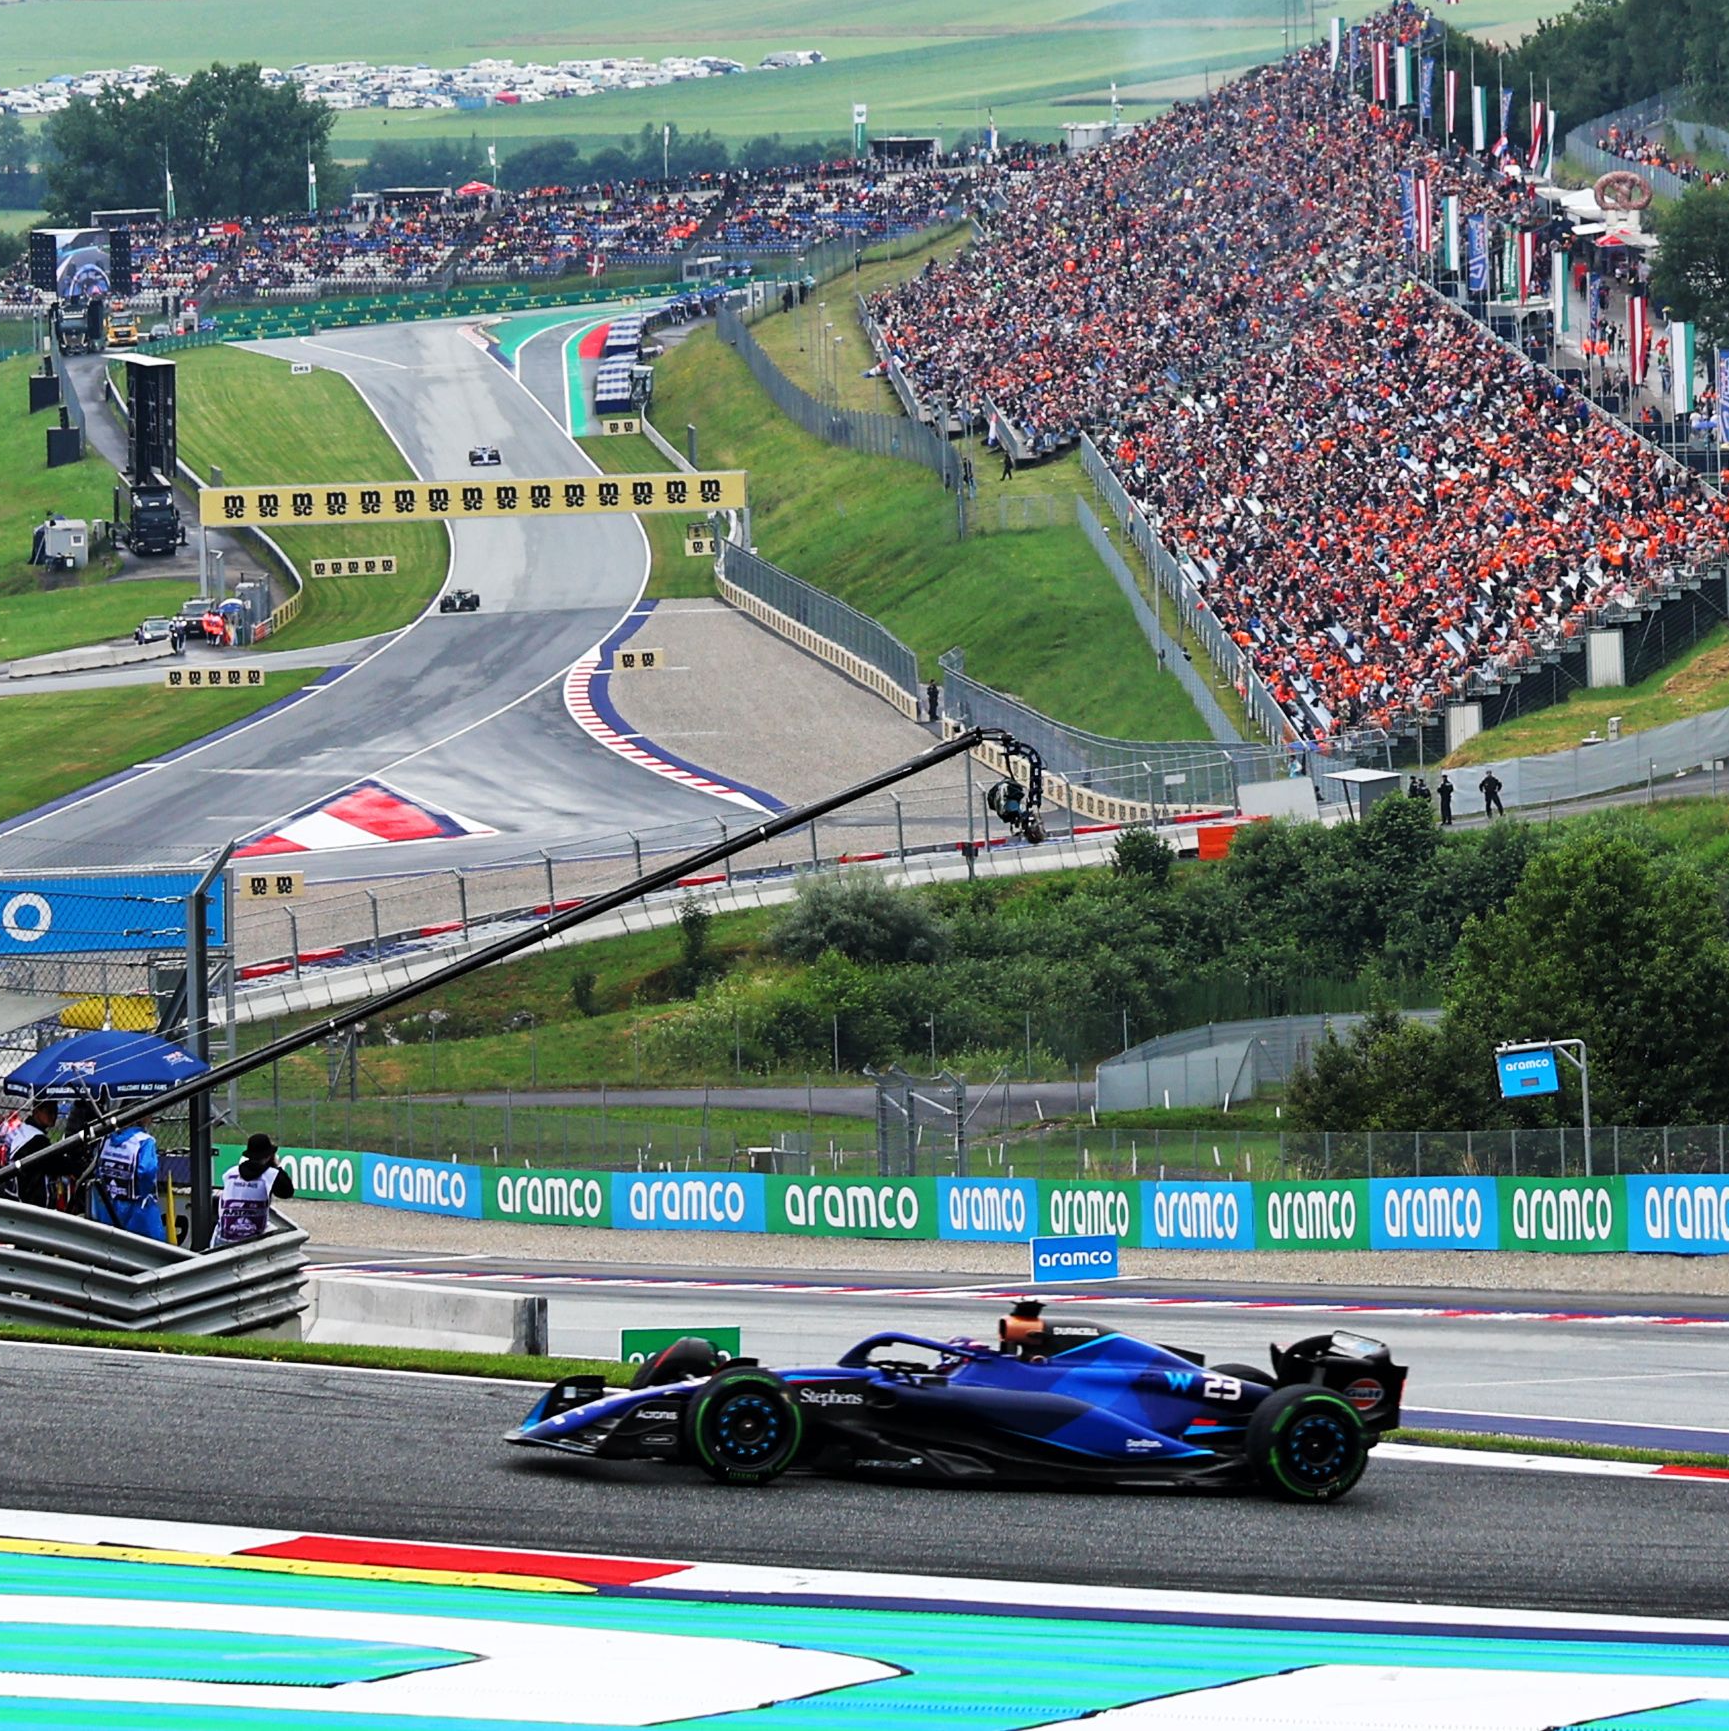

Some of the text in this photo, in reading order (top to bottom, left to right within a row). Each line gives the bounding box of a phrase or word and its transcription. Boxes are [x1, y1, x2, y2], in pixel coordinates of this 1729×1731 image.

[1505, 1057, 1549, 1071] aramco
[280, 1154, 353, 1194] amco
[373, 1162, 466, 1208] aramco
[497, 1176, 602, 1218] aramco
[630, 1181, 745, 1222] aramco
[785, 1184, 919, 1229] aramco
[950, 1187, 1026, 1232] aramco
[1050, 1190, 1129, 1235] aramco
[1154, 1191, 1238, 1239] aramco
[1268, 1190, 1356, 1240] aramco
[1384, 1188, 1481, 1238] aramco
[1513, 1188, 1612, 1241] aramco
[1038, 1249, 1112, 1268] aramco
[1053, 1326, 1099, 1336] DURACELL
[1202, 1373, 1242, 1401] 23
[1344, 1387, 1382, 1402] Gulf
[800, 1388, 864, 1406] Stephens
[635, 1409, 678, 1421] Acronis
